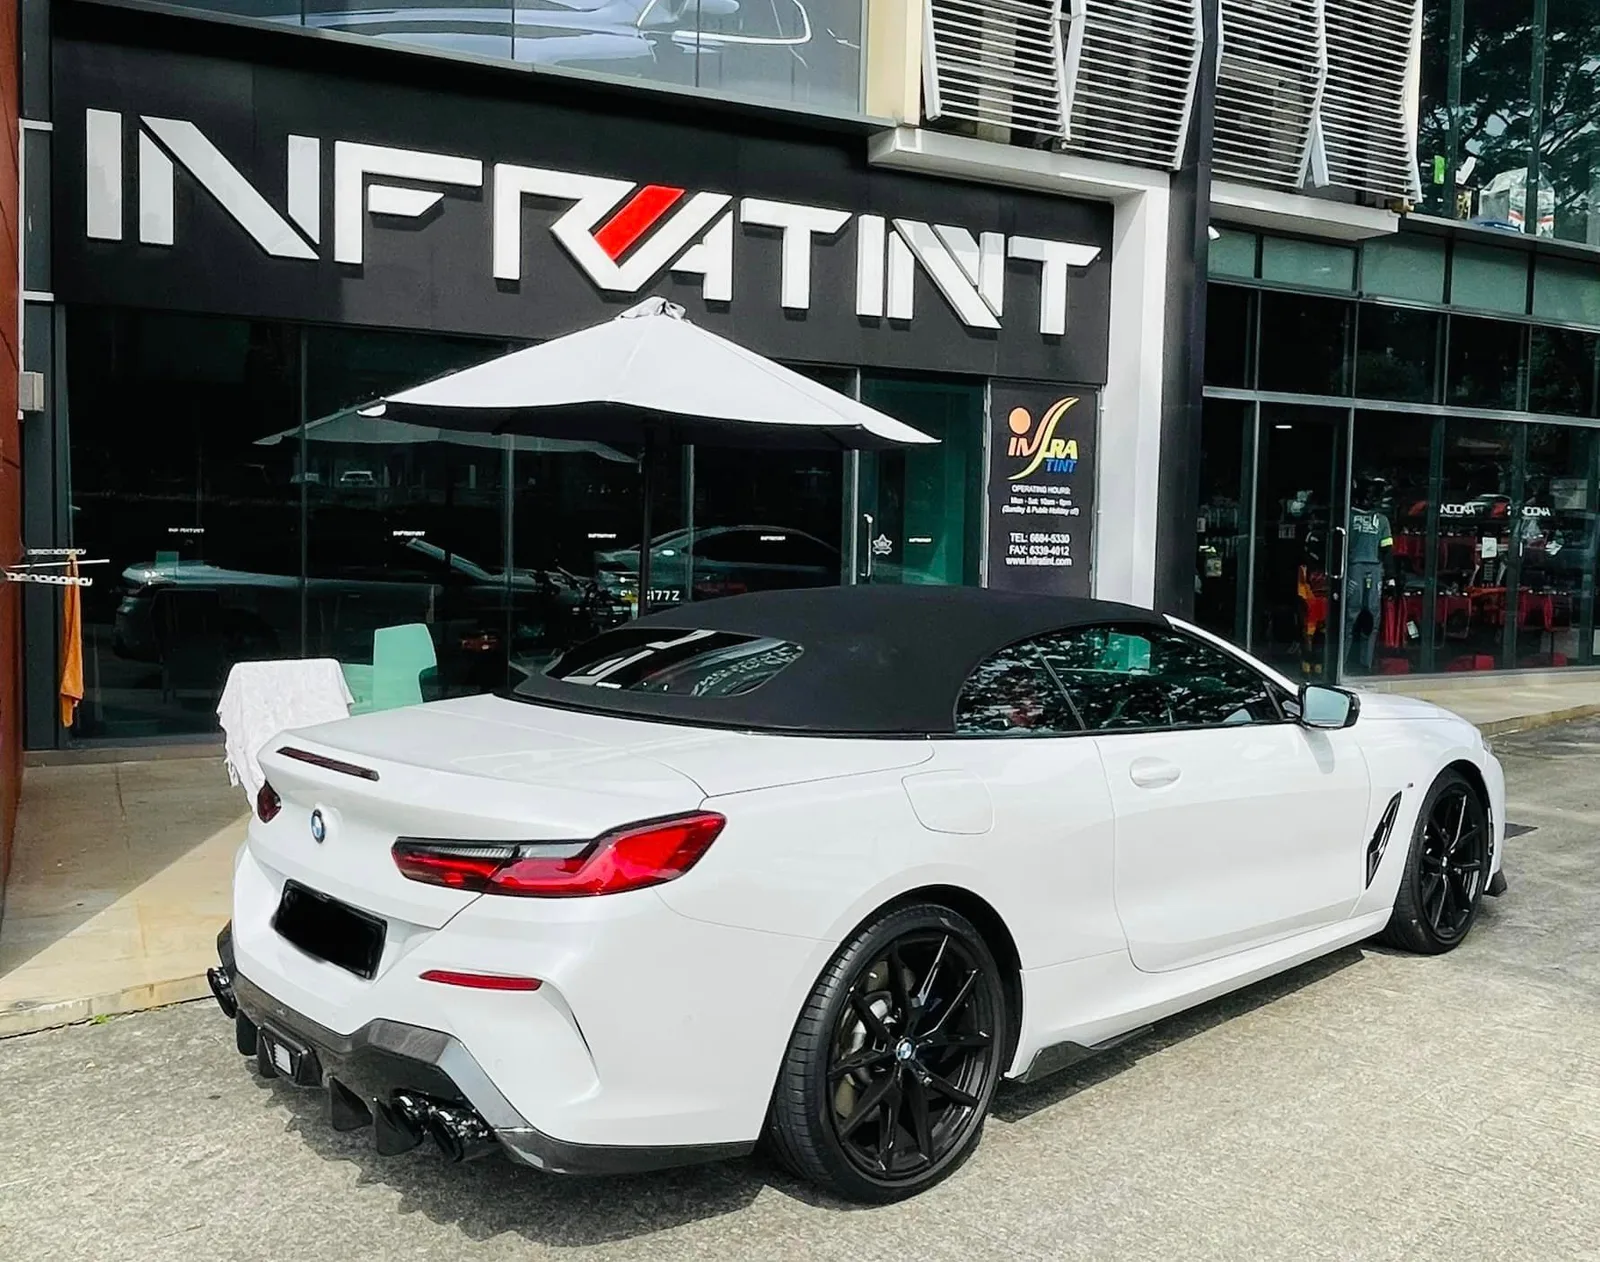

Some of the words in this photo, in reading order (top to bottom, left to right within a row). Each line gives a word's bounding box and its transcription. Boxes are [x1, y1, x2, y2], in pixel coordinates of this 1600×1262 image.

[85, 107, 1102, 336] INFRATINT
[1046, 459, 1078, 473] TINT
[1011, 484, 1047, 494] OPERATING
[1032, 506, 1048, 514] Public
[1010, 532, 1028, 542] TEL:
[1009, 545, 1028, 555] FAX:
